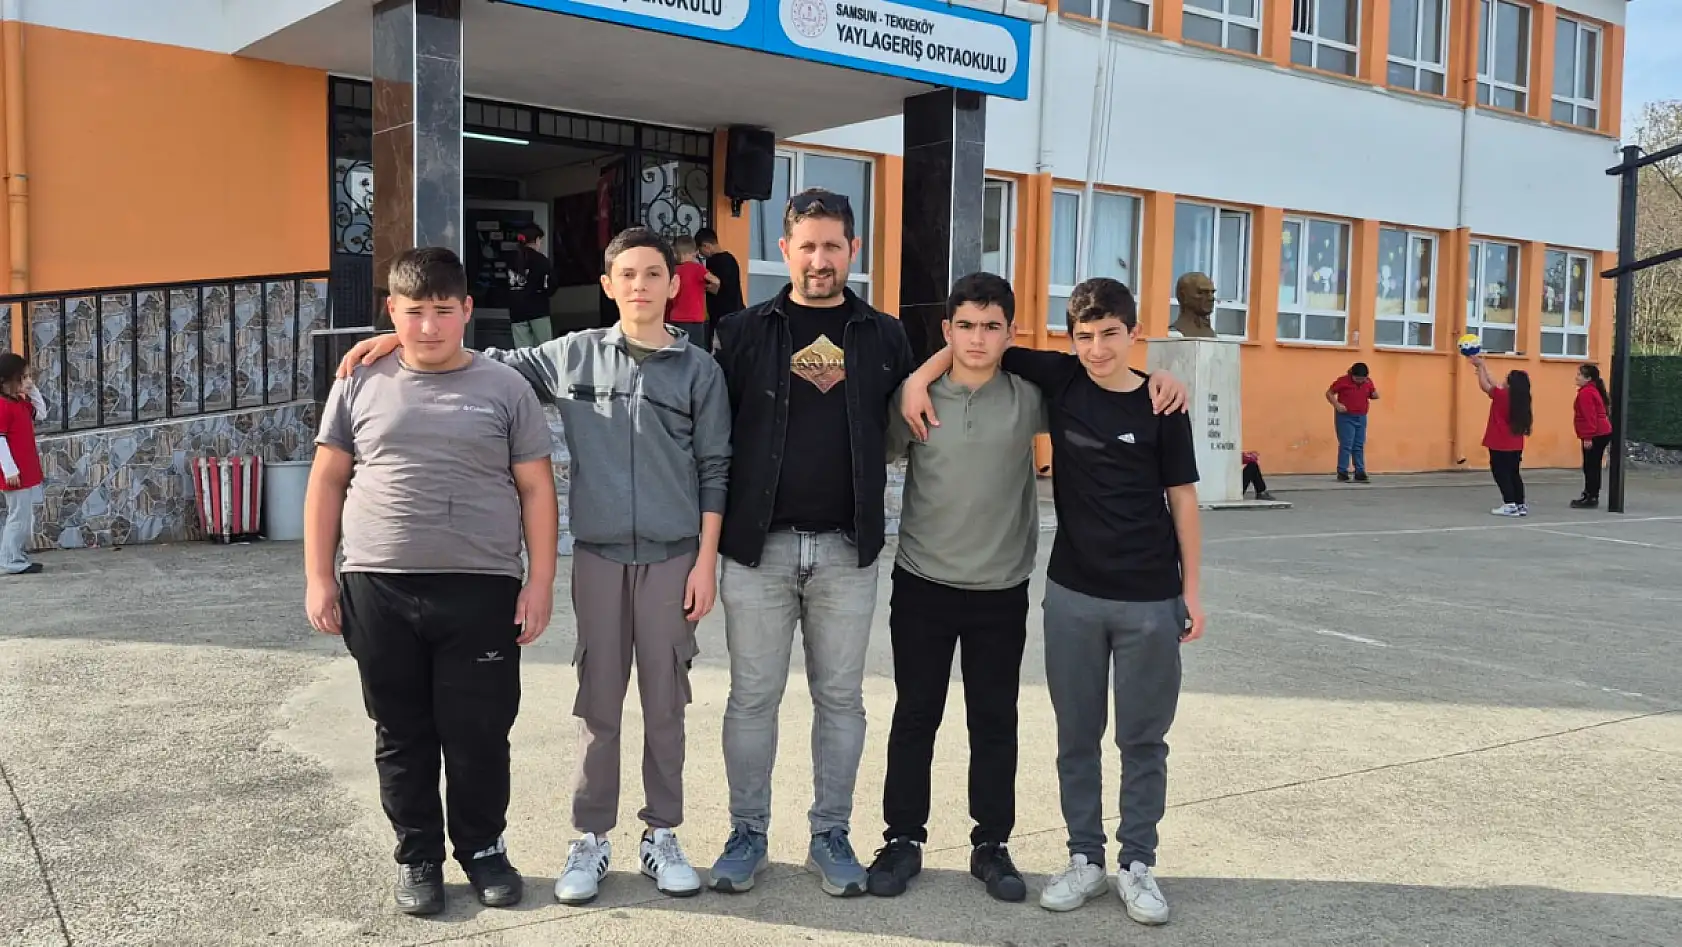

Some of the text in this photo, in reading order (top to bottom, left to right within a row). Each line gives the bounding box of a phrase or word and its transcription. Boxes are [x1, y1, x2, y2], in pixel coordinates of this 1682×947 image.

[836, 3, 877, 23] SAMSUN
[885, 14, 935, 35] TEKKEKÖY
[836, 23, 1006, 74] YAYLAGERİŞ ORTAOKULU
